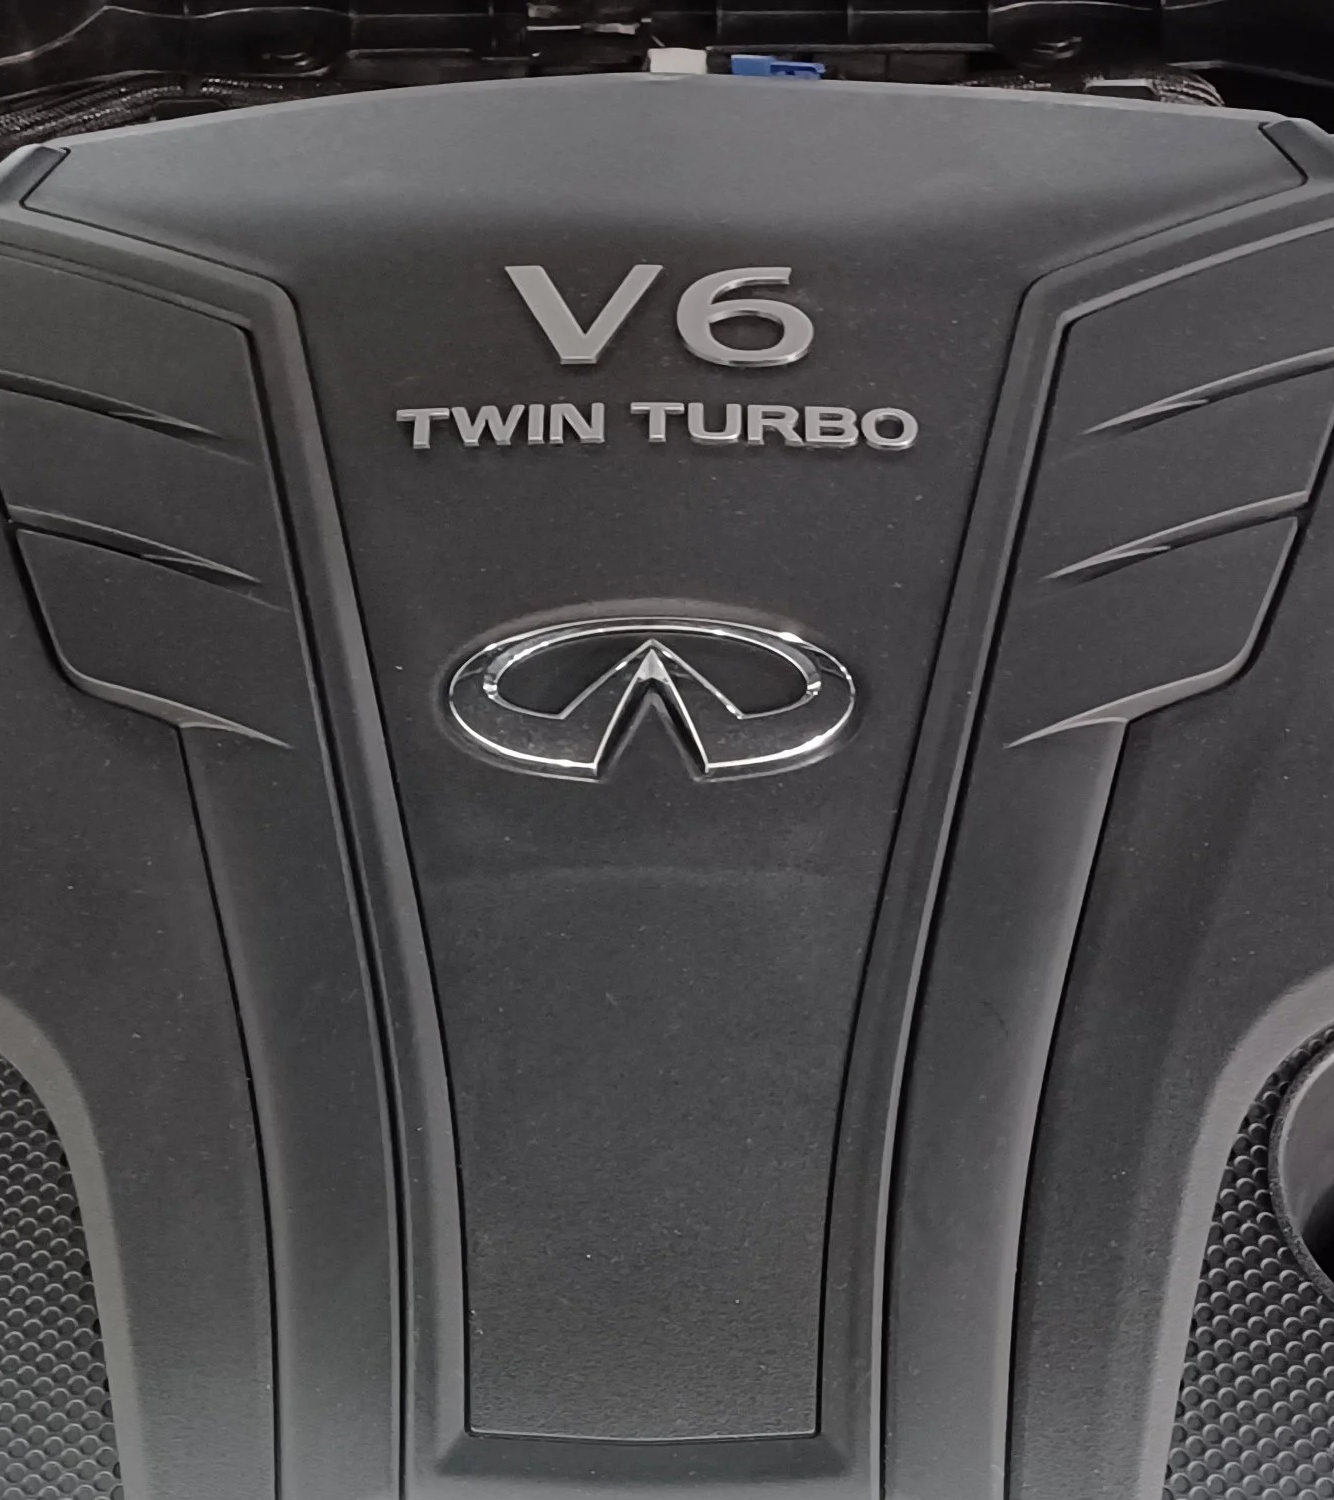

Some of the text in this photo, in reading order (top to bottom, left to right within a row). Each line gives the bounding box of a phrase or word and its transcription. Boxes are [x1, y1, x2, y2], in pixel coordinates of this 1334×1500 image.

[504, 264, 815, 368] V6
[396, 401, 919, 451] TWIN TURBO
